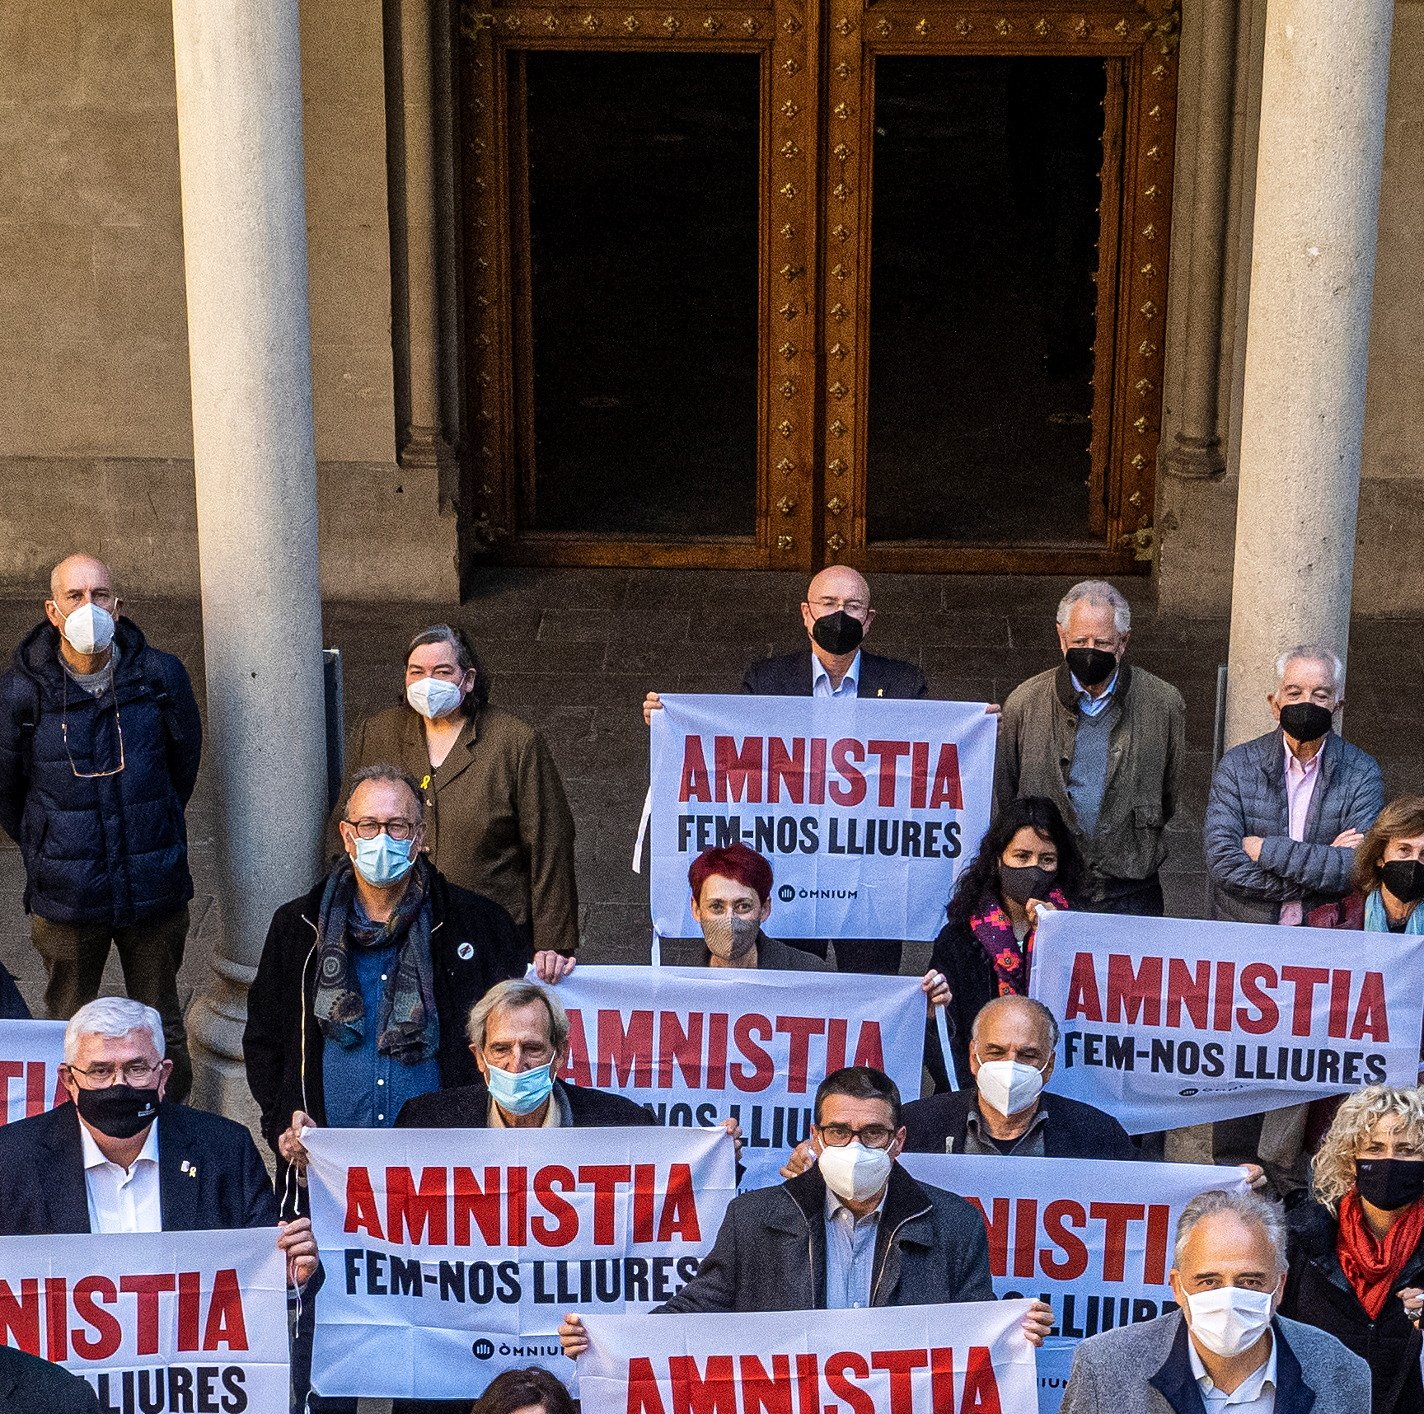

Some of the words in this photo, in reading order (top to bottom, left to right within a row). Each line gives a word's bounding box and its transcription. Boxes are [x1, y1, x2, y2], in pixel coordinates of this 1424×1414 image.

[678, 735, 964, 809] AMNISTIA
[678, 814, 819, 854] FEM-NOS
[828, 818, 962, 859] LLIURES
[799, 887, 858, 899] ÒMNIUM
[1065, 952, 1390, 1042] AMNISTIA
[1064, 1031, 1224, 1077] FEM-NOS
[1235, 1045, 1387, 1085] LLIURES
[344, 1164, 702, 1247] AMNISTIA
[964, 1196, 1176, 1286] NISTI
[344, 1248, 522, 1304] FEM-NOS
[499, 1342, 565, 1357] ÒMNIU
